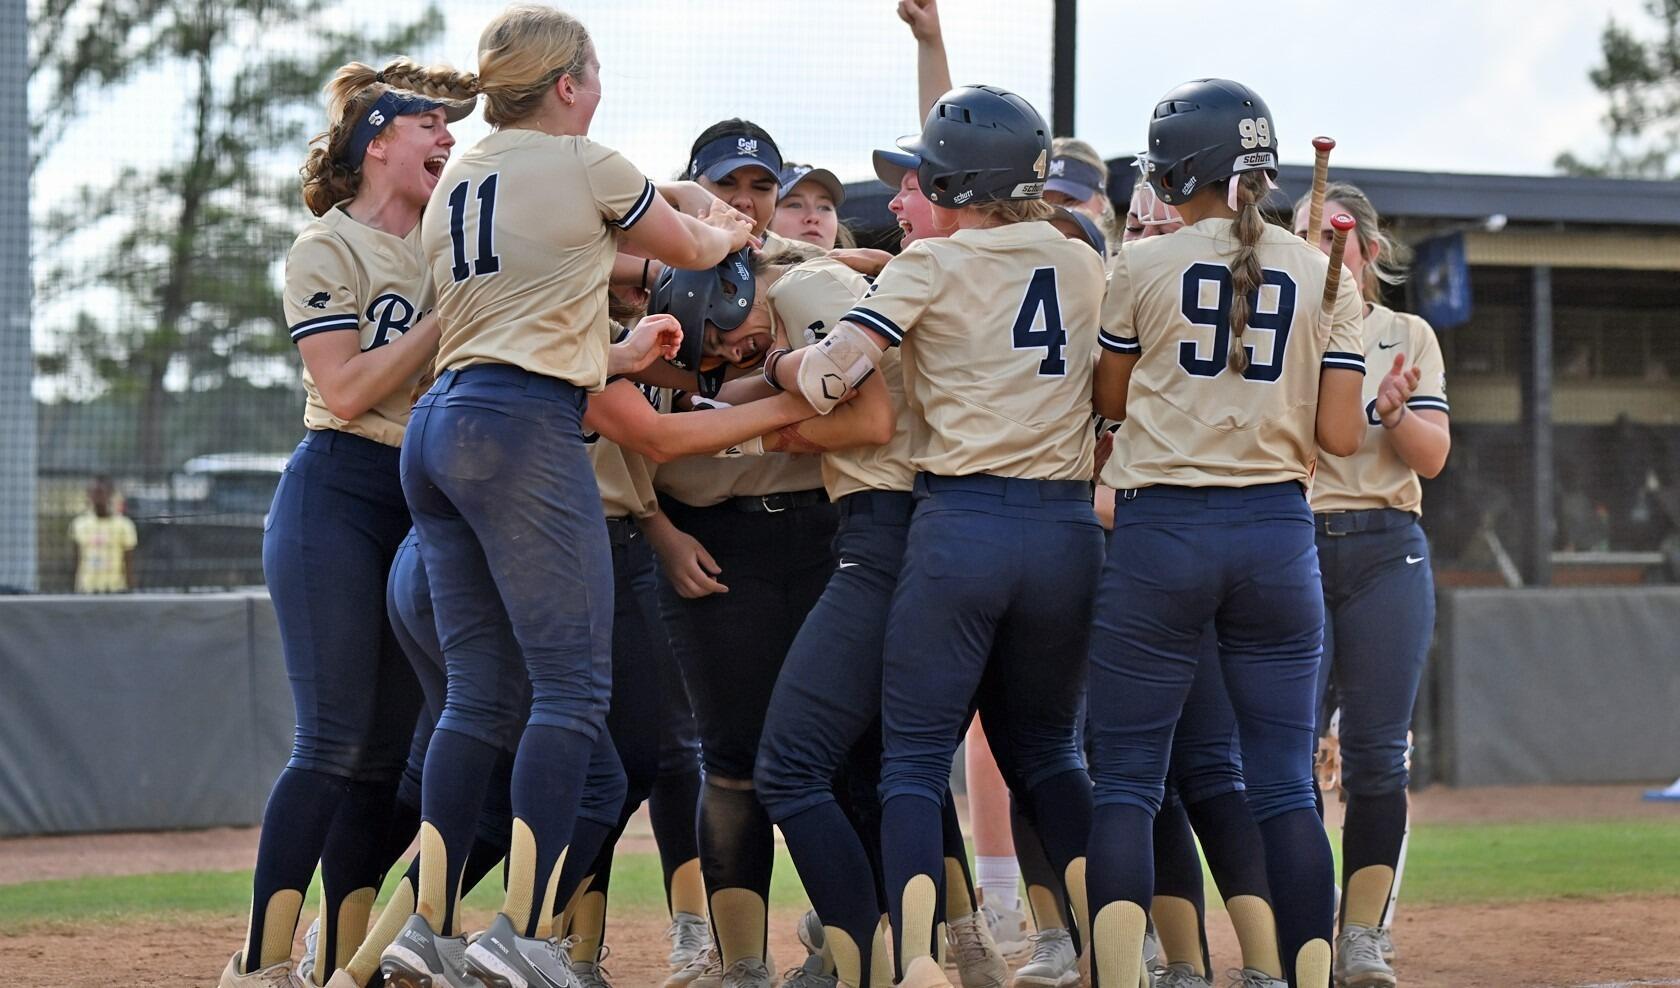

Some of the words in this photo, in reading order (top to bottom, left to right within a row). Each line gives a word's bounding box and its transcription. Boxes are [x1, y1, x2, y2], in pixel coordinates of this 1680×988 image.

[738, 138, 757, 151] CSU
[1238, 117, 1270, 149] 99
[1033, 149, 1046, 178] 4
[953, 189, 974, 204] schutt
[448, 171, 501, 284] 11
[1012, 266, 1067, 377] 4
[1177, 261, 1297, 384] 99
